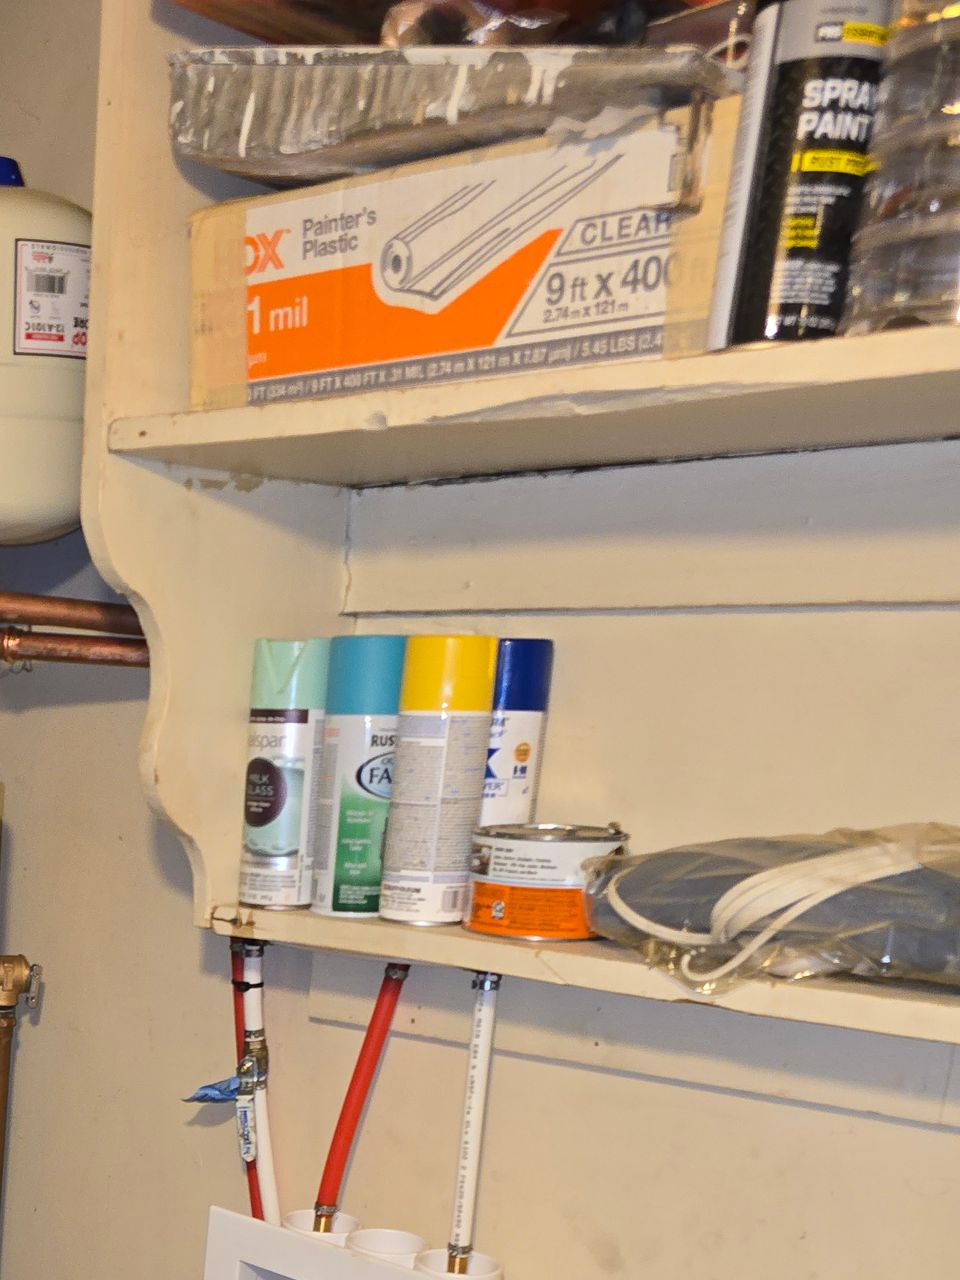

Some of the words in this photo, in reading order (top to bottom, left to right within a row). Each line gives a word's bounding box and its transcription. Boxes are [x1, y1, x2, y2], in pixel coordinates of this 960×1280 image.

[796, 110, 872, 142] PAINT
[302, 207, 377, 239] Painter's
[580, 209, 674, 245] CLEAR
[302, 233, 359, 260] Plastic
[546, 272, 565, 306] 9
[571, 277, 588, 304] ft
[268, 296, 309, 332] mil
[543, 307, 569, 324] 2.74
[571, 309, 581, 320] m
[594, 299, 617, 316] 121
[618, 302, 629, 313] m
[253, 387, 266, 400] FT
[320, 378, 333, 392] FT
[363, 372, 377, 386] FT
[378, 370, 386, 382] X
[405, 365, 424, 379] MIL
[466, 357, 474, 370] X
[512, 351, 520, 366] X
[581, 339, 608, 357] 5.45
[609, 335, 635, 353] LBS
